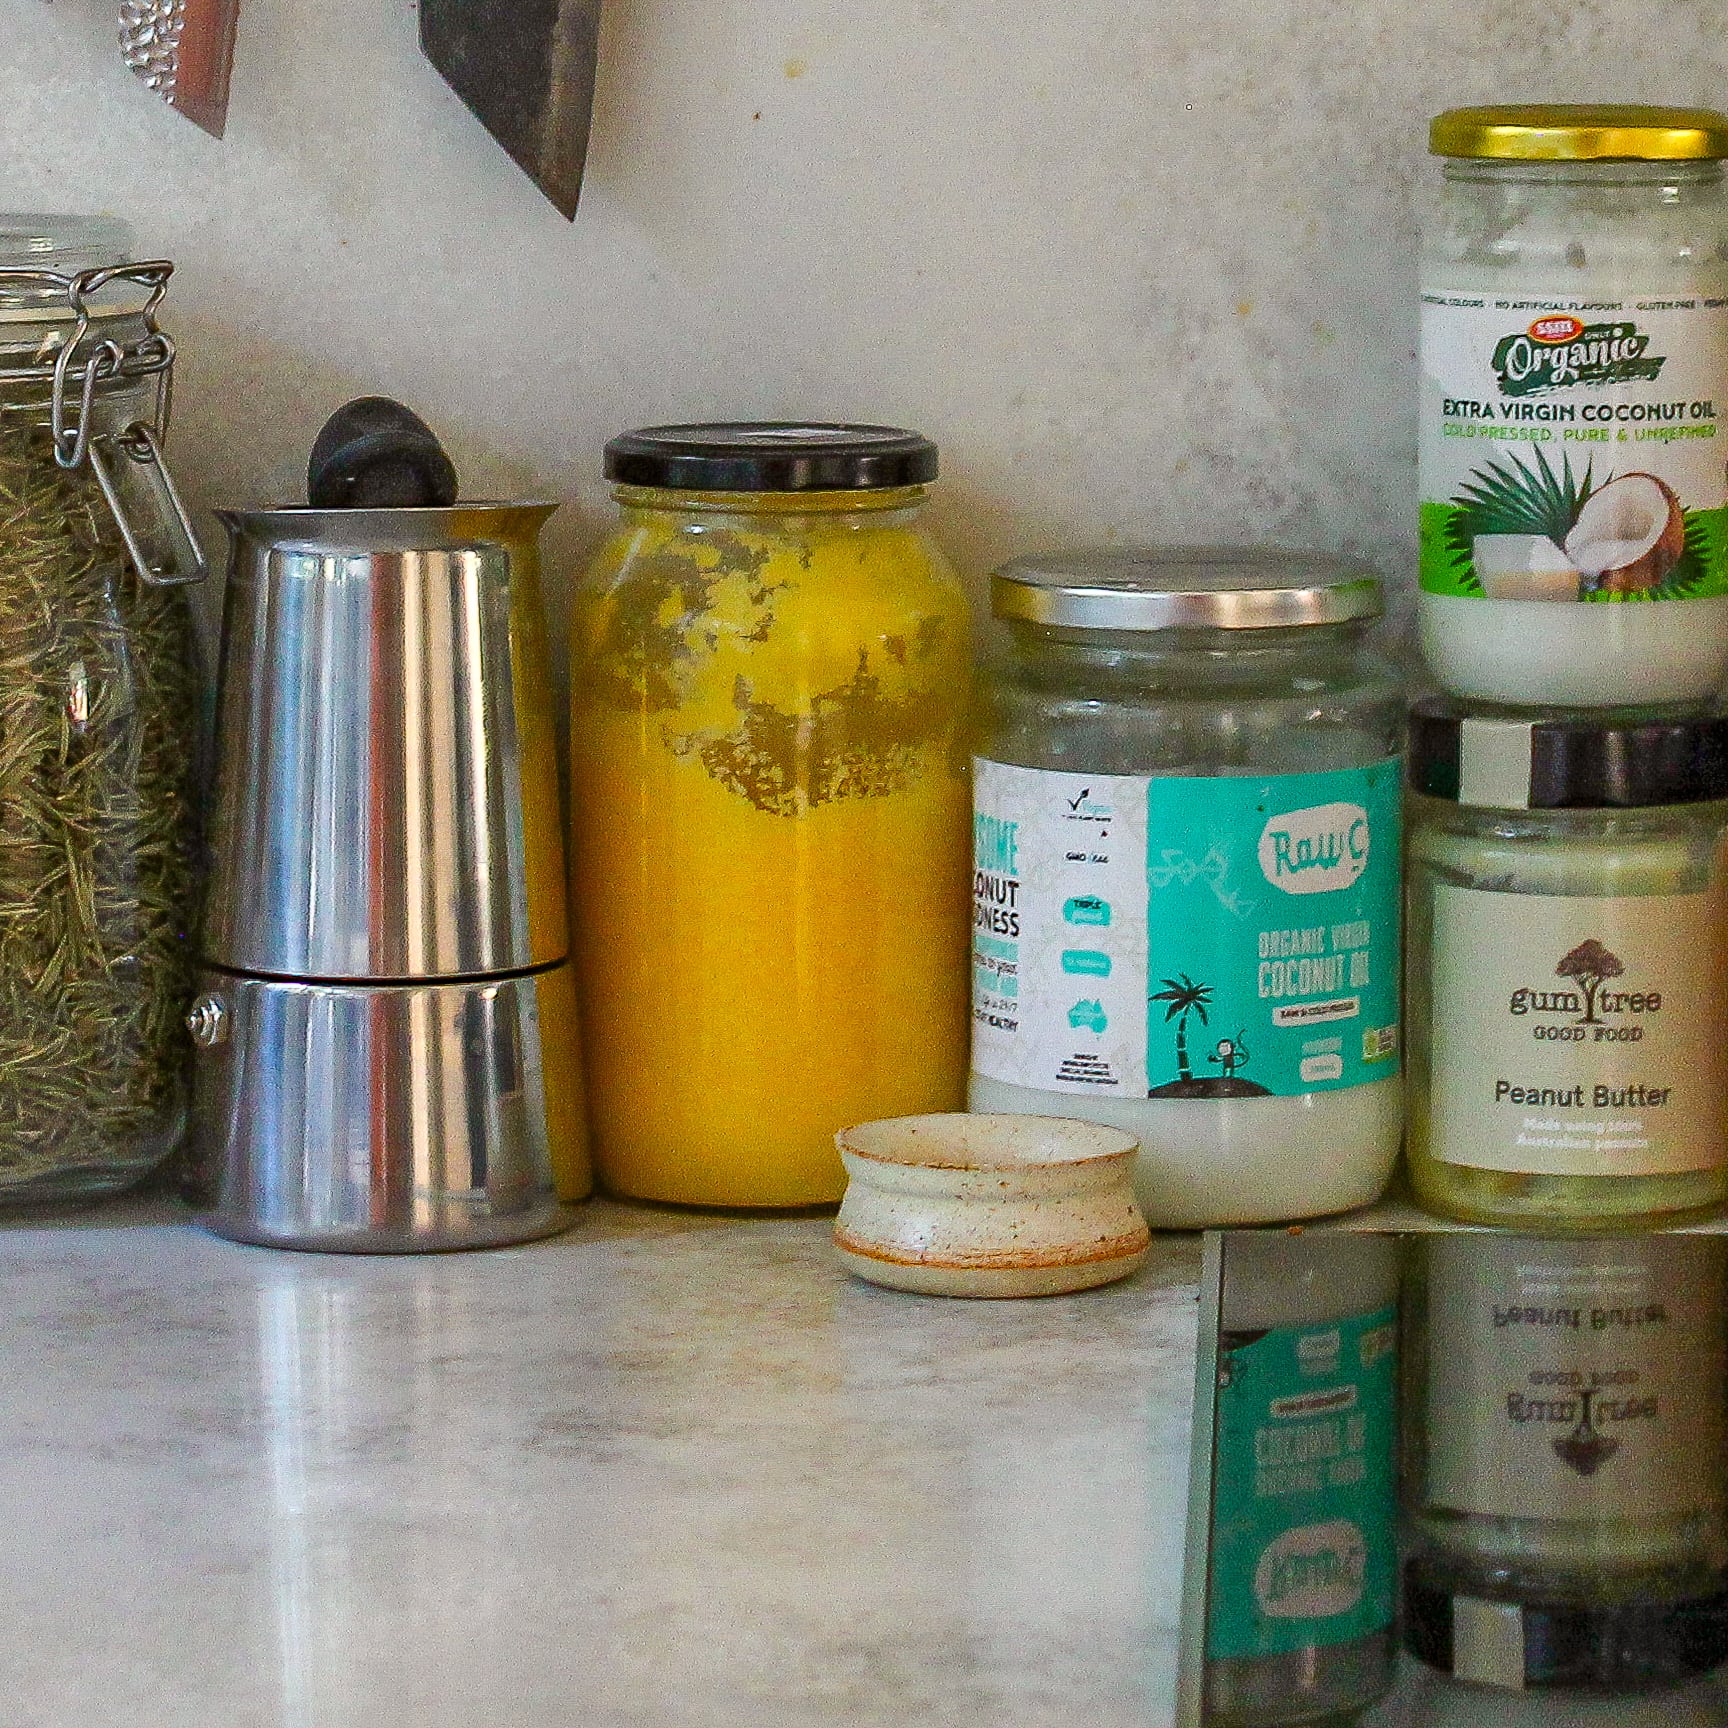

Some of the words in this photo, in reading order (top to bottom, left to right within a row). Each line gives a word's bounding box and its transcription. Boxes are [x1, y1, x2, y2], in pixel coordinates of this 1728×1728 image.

[1506, 327, 1641, 383] Organic
[1443, 398, 1495, 419] EXTRA
[1499, 401, 1575, 421] VIRGIN
[1582, 402, 1686, 421] COCONUT
[1689, 399, 1717, 420] OIL
[1564, 427, 1610, 442] PURE
[1616, 428, 1628, 442] &
[1258, 925, 1324, 959] ORGANIC
[1258, 953, 1345, 998] COCONUT
[1510, 986, 1583, 1016] gum
[1599, 988, 1663, 1014] tree
[1532, 1025, 1586, 1042] GOOD
[1593, 1025, 1644, 1043] FOOD
[1495, 1080, 1586, 1108] Peanut
[1592, 1084, 1672, 1109] Butter
